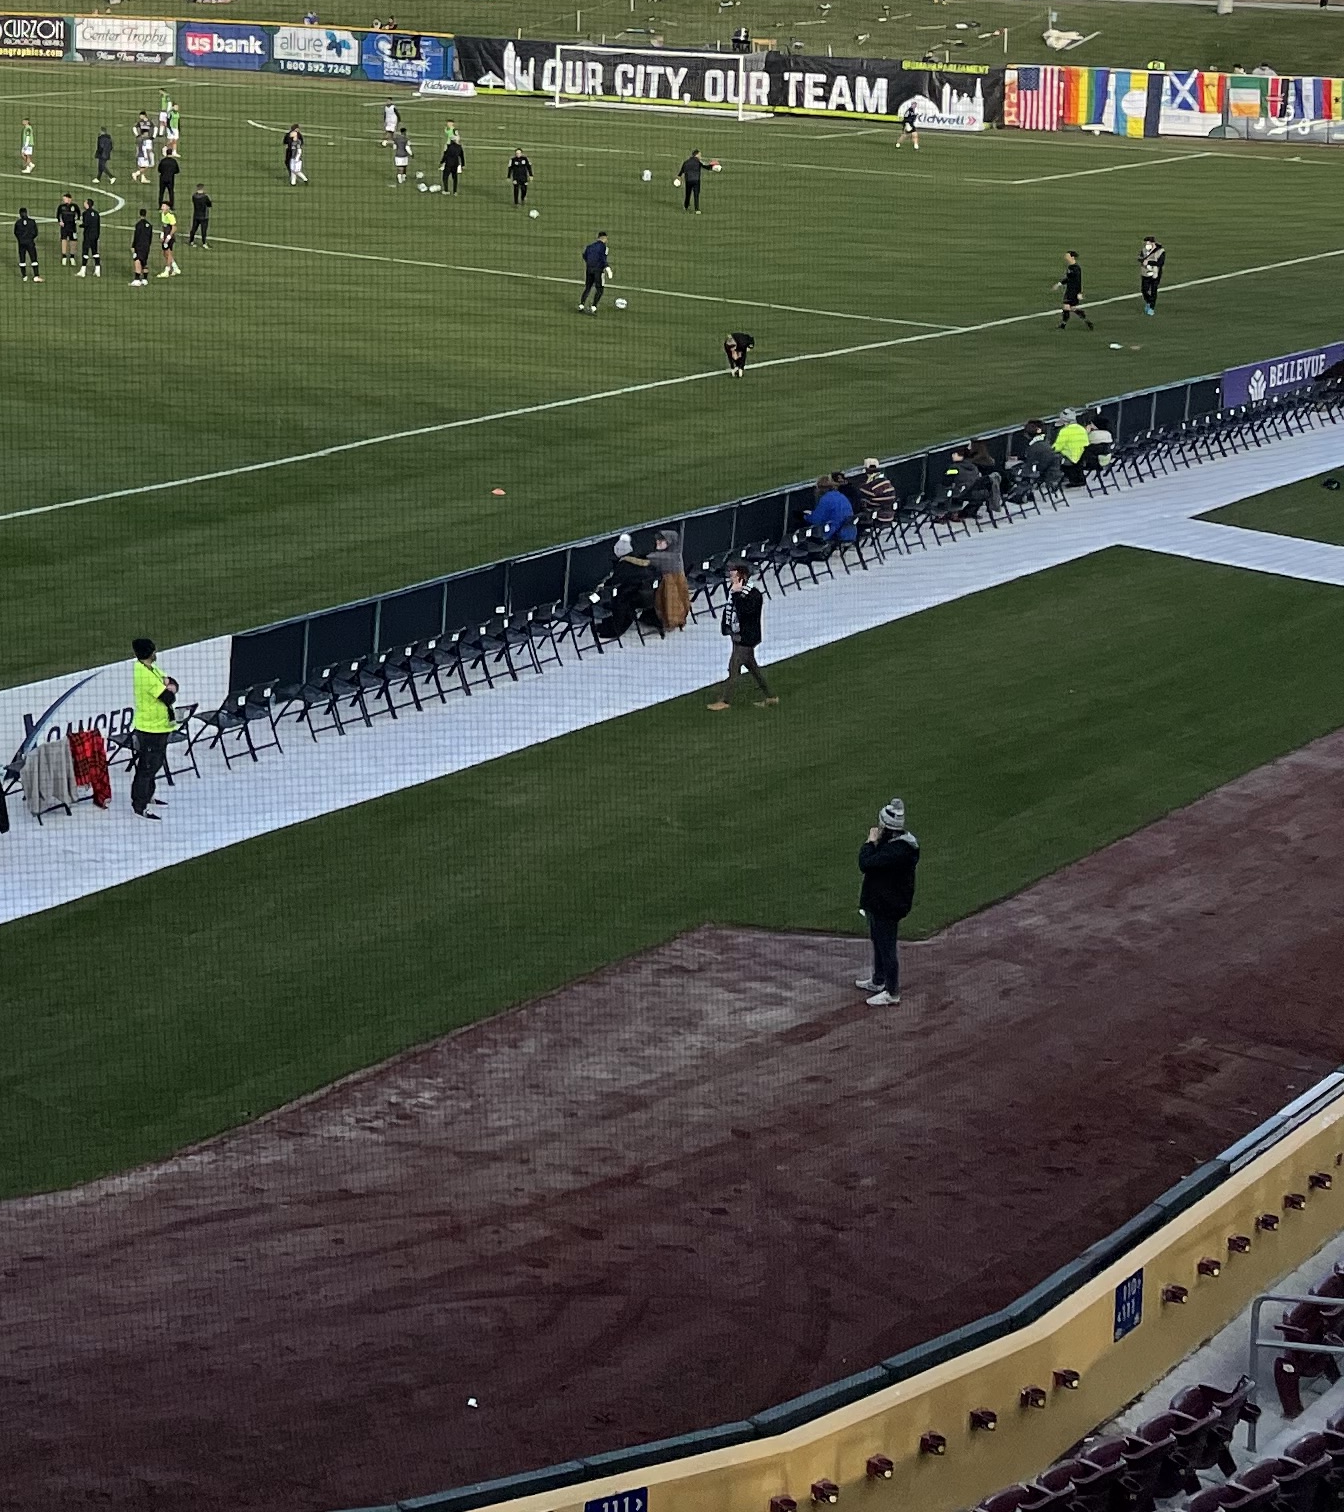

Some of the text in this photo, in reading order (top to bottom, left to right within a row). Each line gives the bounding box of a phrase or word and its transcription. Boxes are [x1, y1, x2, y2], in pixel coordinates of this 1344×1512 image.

[3, 19, 65, 40] CURZON
[82, 26, 168, 46] Center Trophy
[280, 32, 323, 53] allure
[542, 58, 889, 114] OUR CITY, OUR TEAM
[915, 113, 965, 126] Kidwell
[1269, 353, 1326, 388] BELLEVUE
